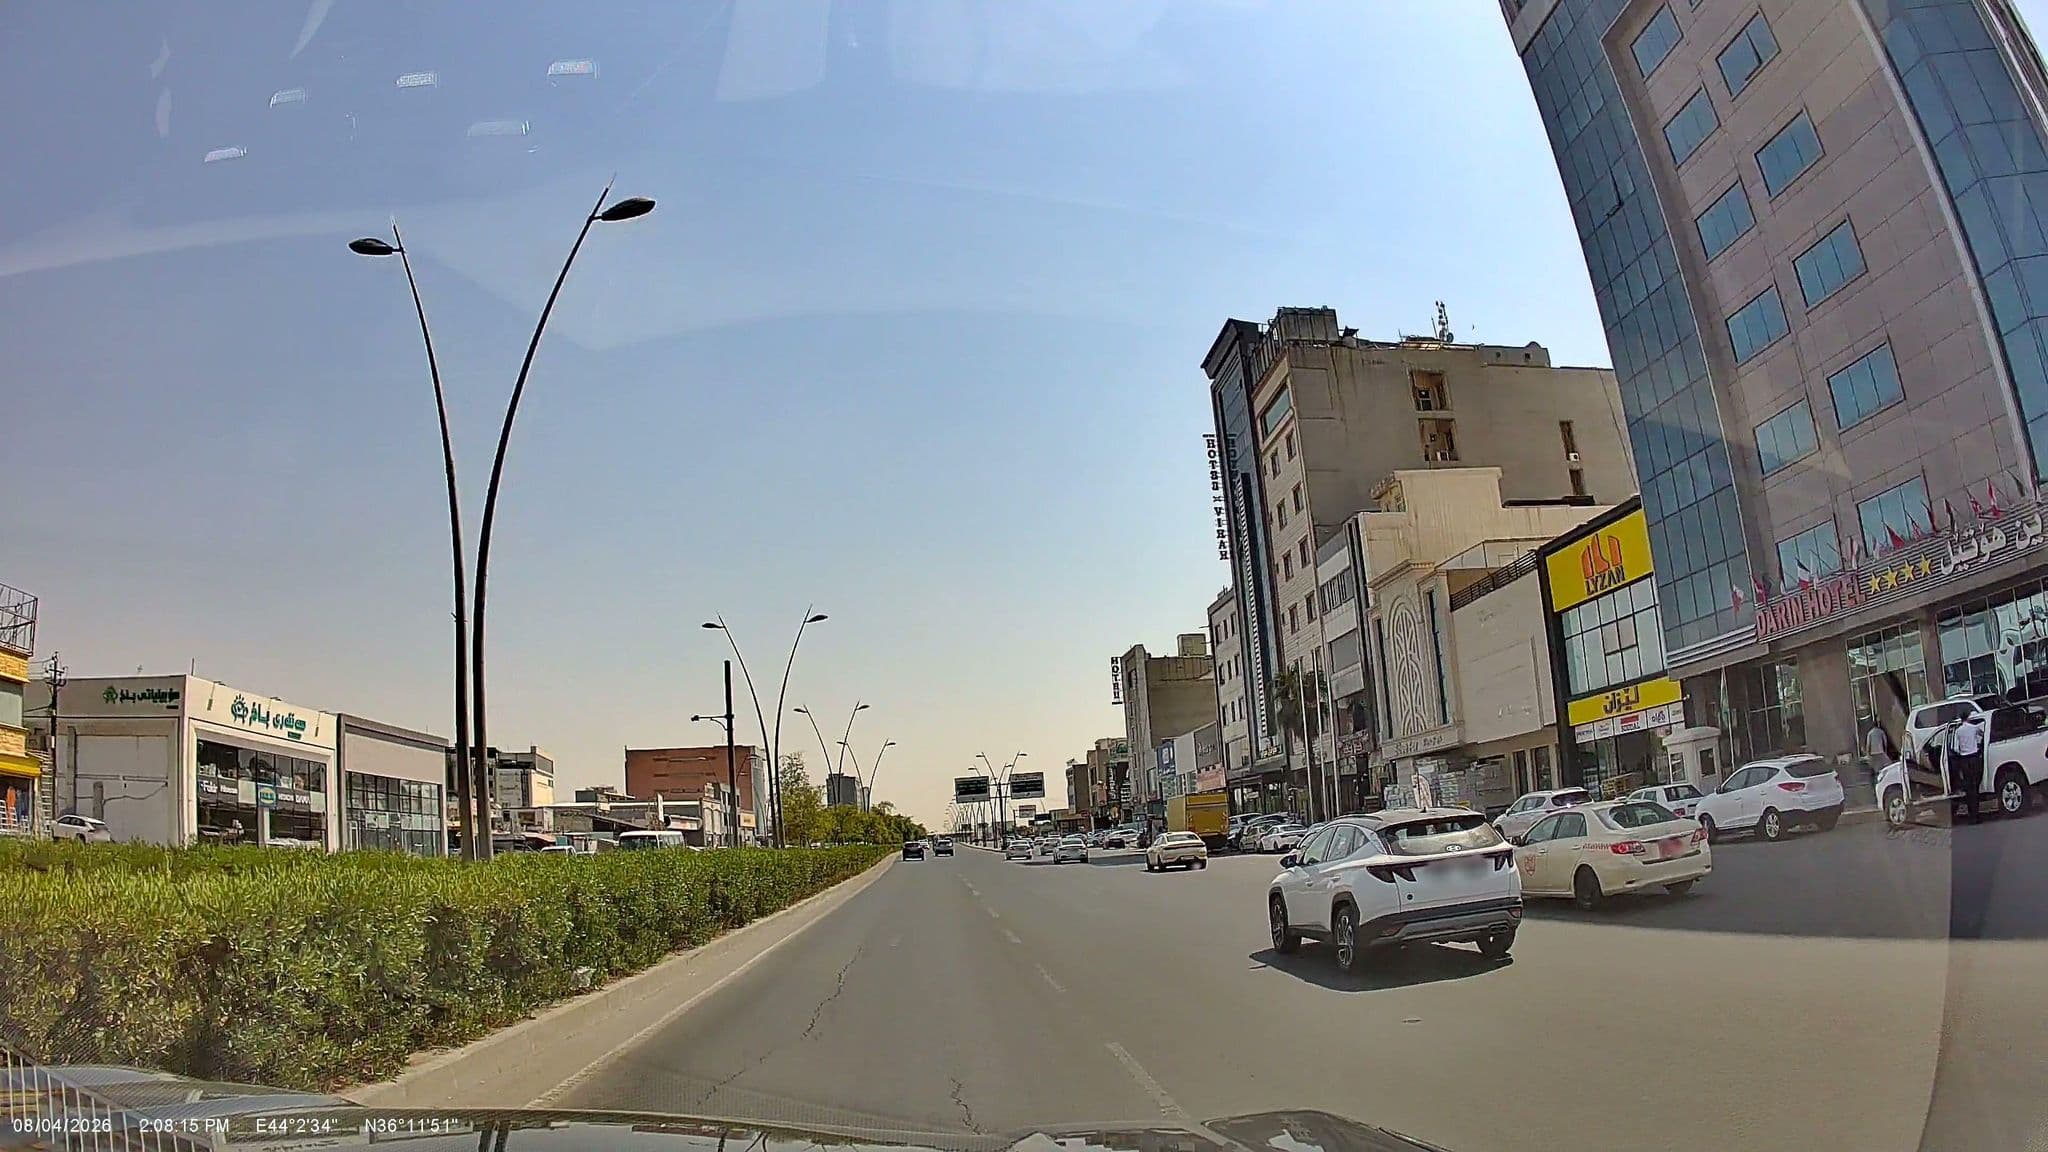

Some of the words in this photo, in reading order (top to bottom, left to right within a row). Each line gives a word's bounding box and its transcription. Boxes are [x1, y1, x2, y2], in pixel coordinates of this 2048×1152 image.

[1585, 565, 1625, 595] LYZAN
[1756, 595, 1806, 637] DARIN
[1805, 570, 1867, 620] HOTEL
